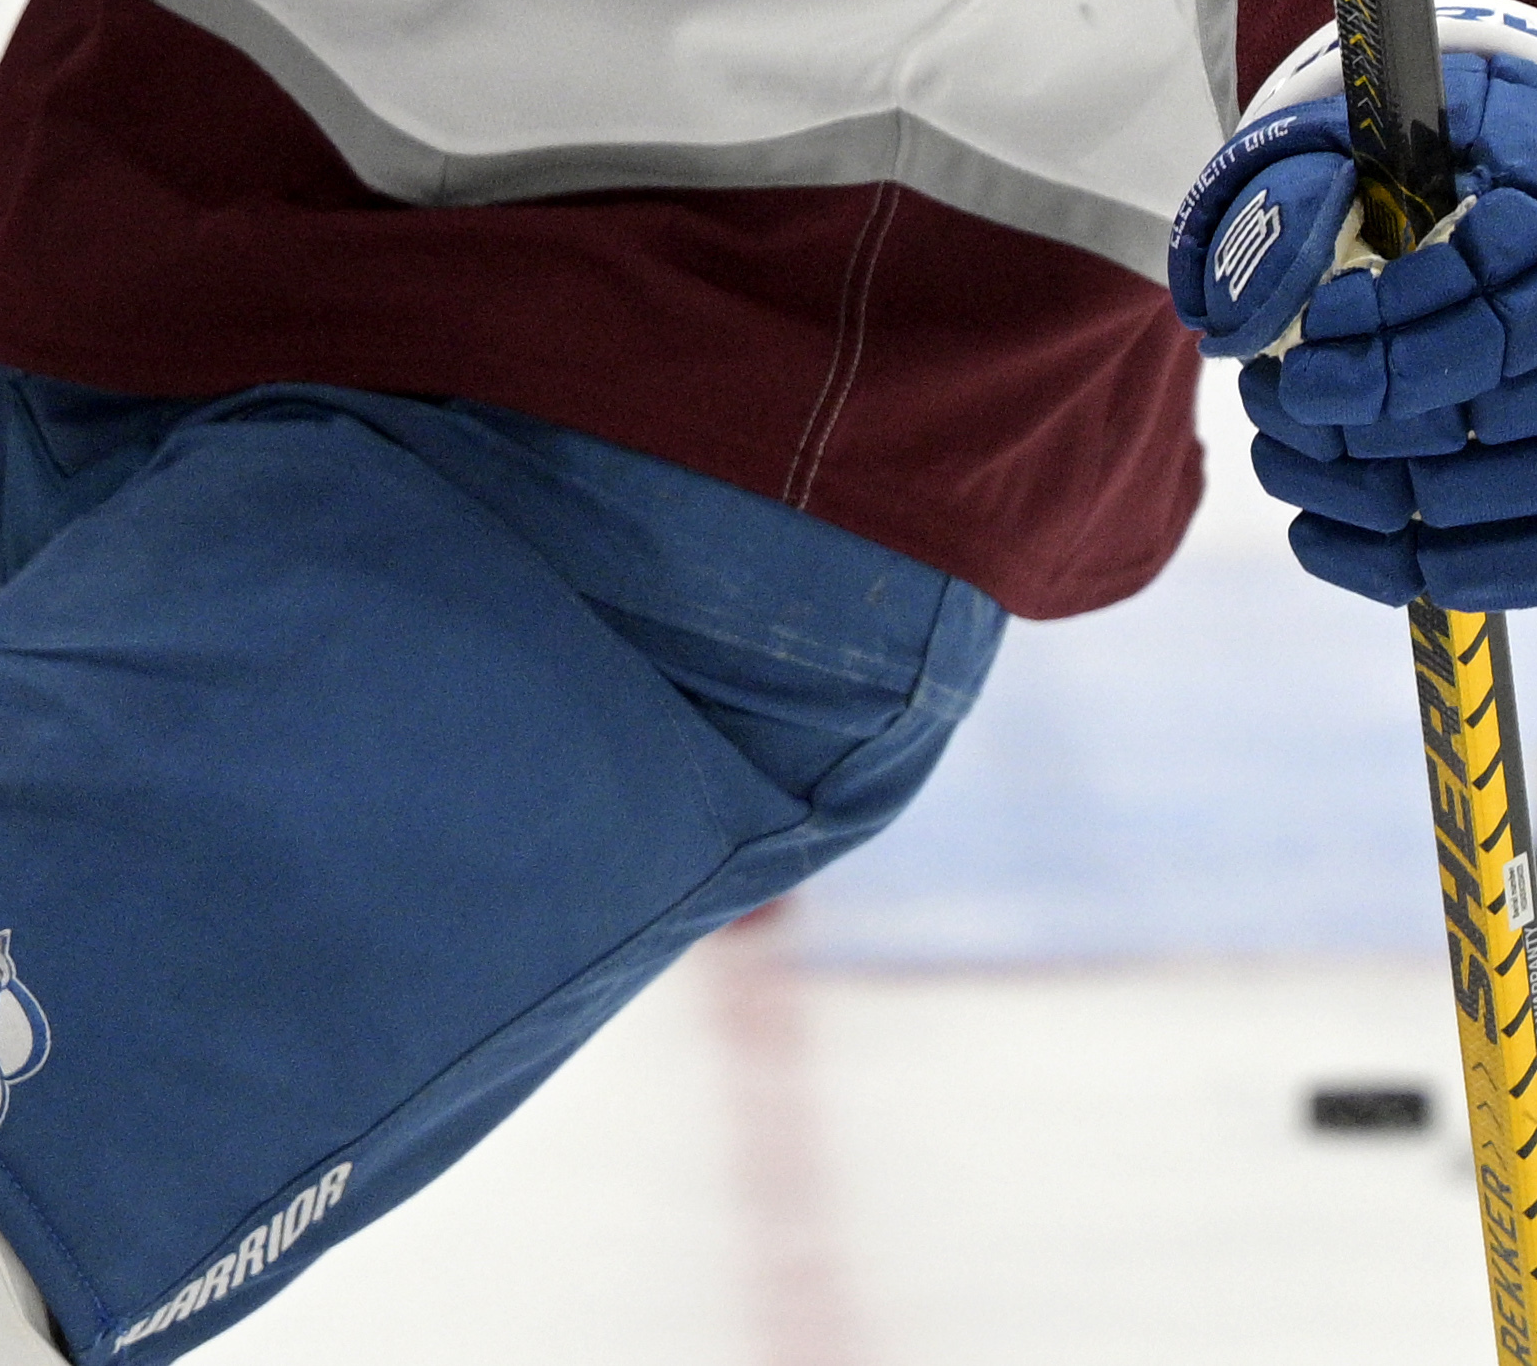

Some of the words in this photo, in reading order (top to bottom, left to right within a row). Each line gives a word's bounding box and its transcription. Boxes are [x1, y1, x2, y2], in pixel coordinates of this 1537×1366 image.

[1407, 593, 1498, 1046] SHERW
[113, 1161, 352, 1353] WARRIOR
[1481, 1164, 1533, 1366] REKKER
